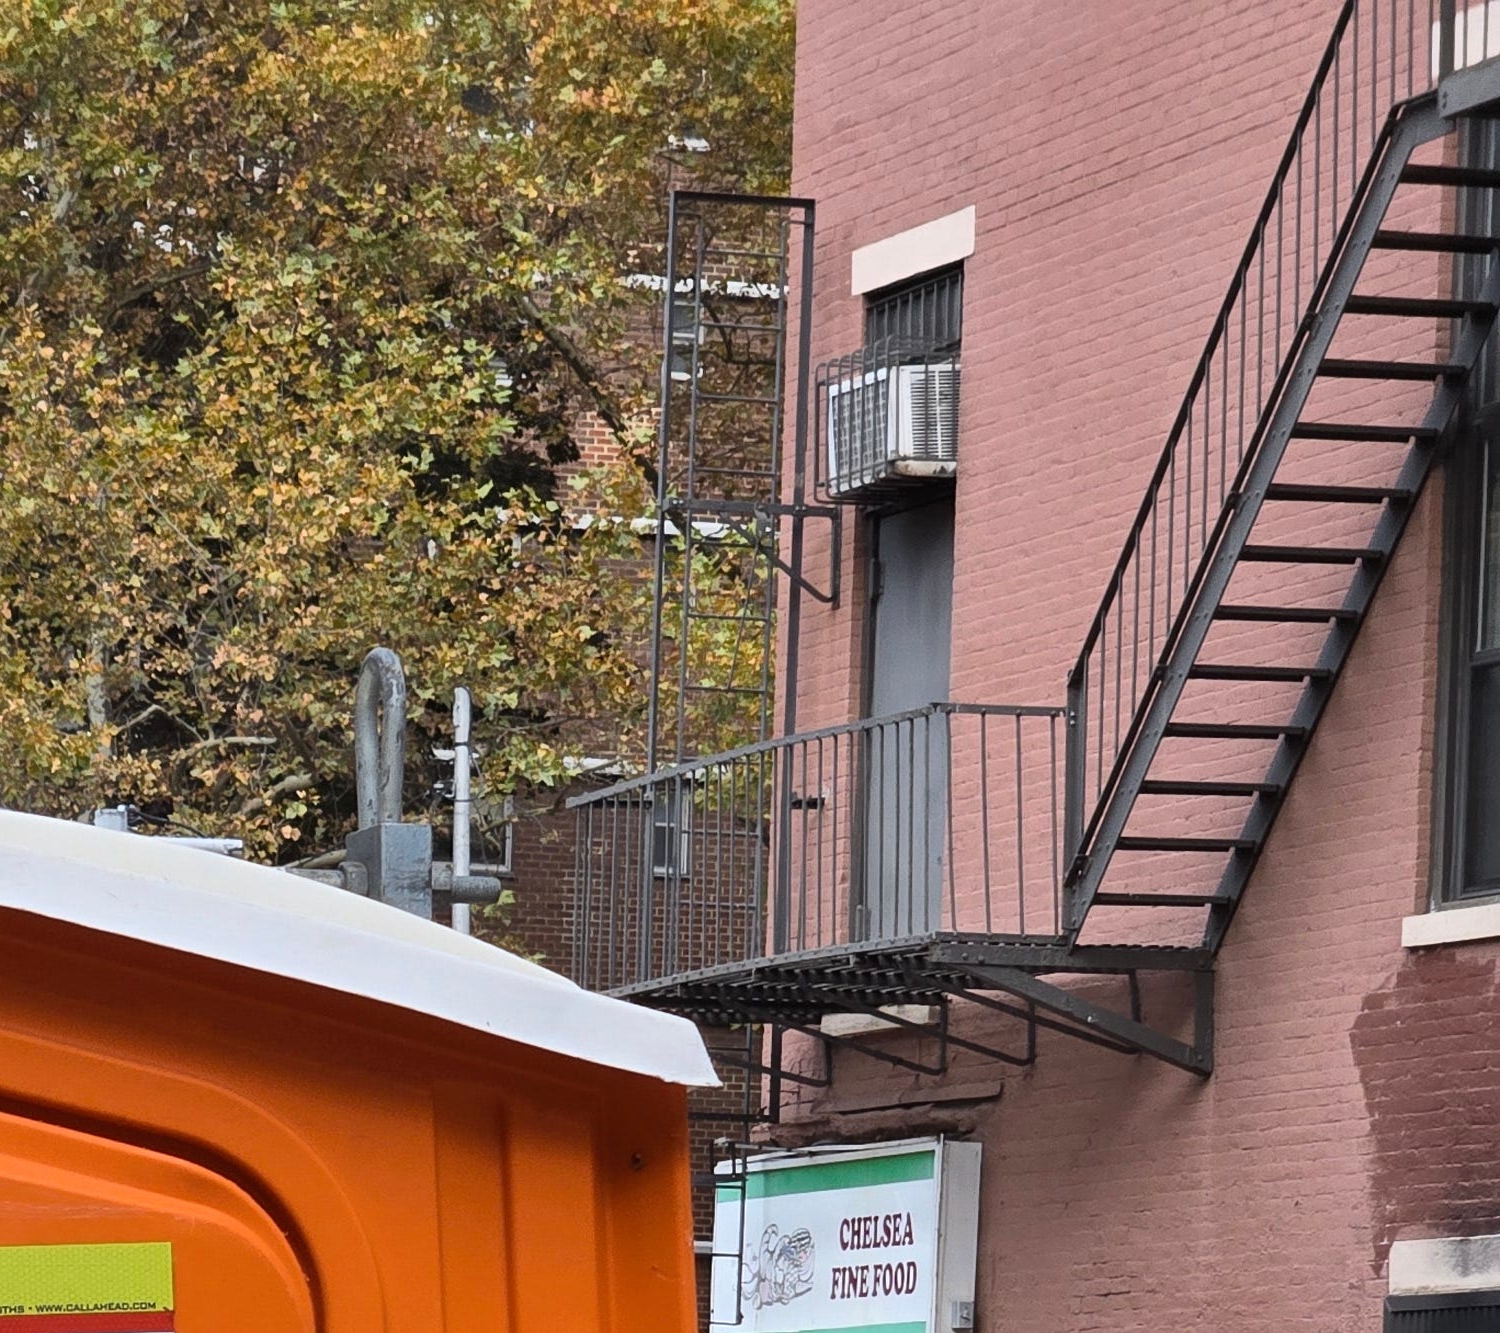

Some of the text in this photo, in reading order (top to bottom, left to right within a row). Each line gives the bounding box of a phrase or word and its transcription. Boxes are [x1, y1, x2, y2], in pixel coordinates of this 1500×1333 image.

[840, 1211, 914, 1251] CHELSEA
[830, 1261, 917, 1299] FINE FOOD
[35, 1301, 157, 1313] WWW.CALLAHEAD.COM
